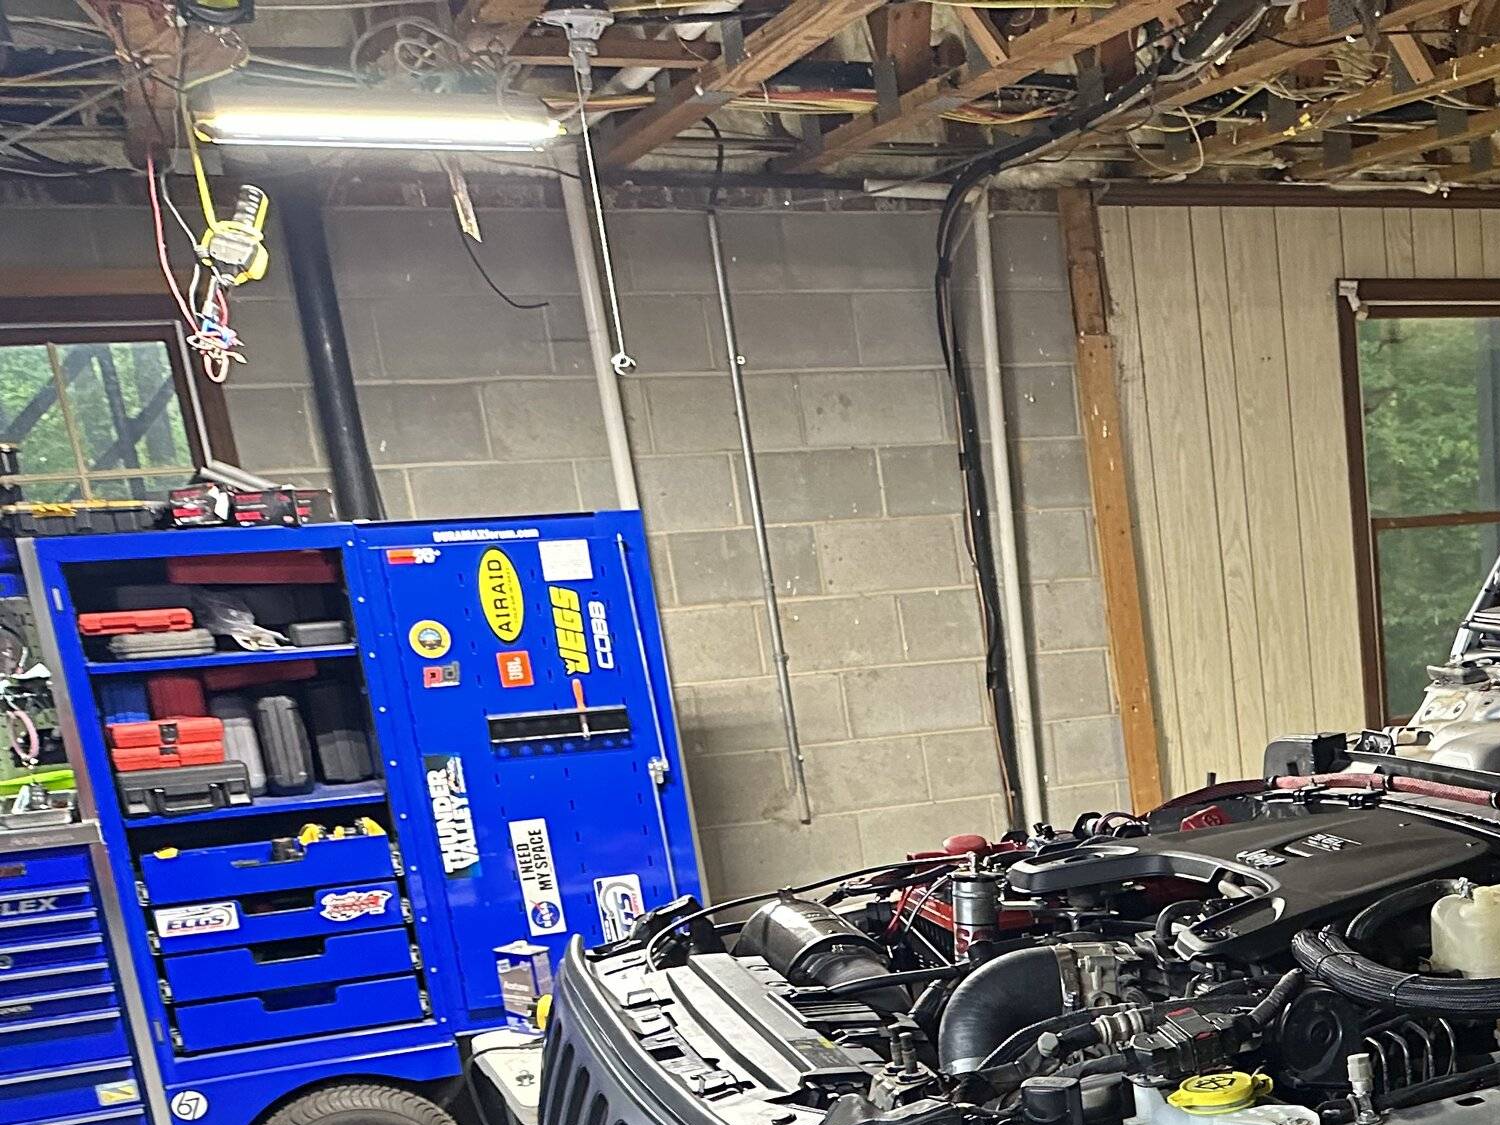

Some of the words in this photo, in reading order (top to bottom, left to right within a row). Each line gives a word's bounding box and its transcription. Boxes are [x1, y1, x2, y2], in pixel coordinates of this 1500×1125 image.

[487, 559, 513, 633] AIRAID
[549, 586, 590, 675] JEGS
[588, 600, 614, 669] COBB
[507, 656, 525, 680] JBL
[427, 768, 458, 874] THUNDER
[449, 792, 480, 870] VALLEY
[516, 842, 533, 873] NEED
[528, 828, 548, 869] SPACE
[1236, 849, 1285, 869] Jeep
[536, 871, 553, 891] MY
[177, 1091, 200, 1120] 67
